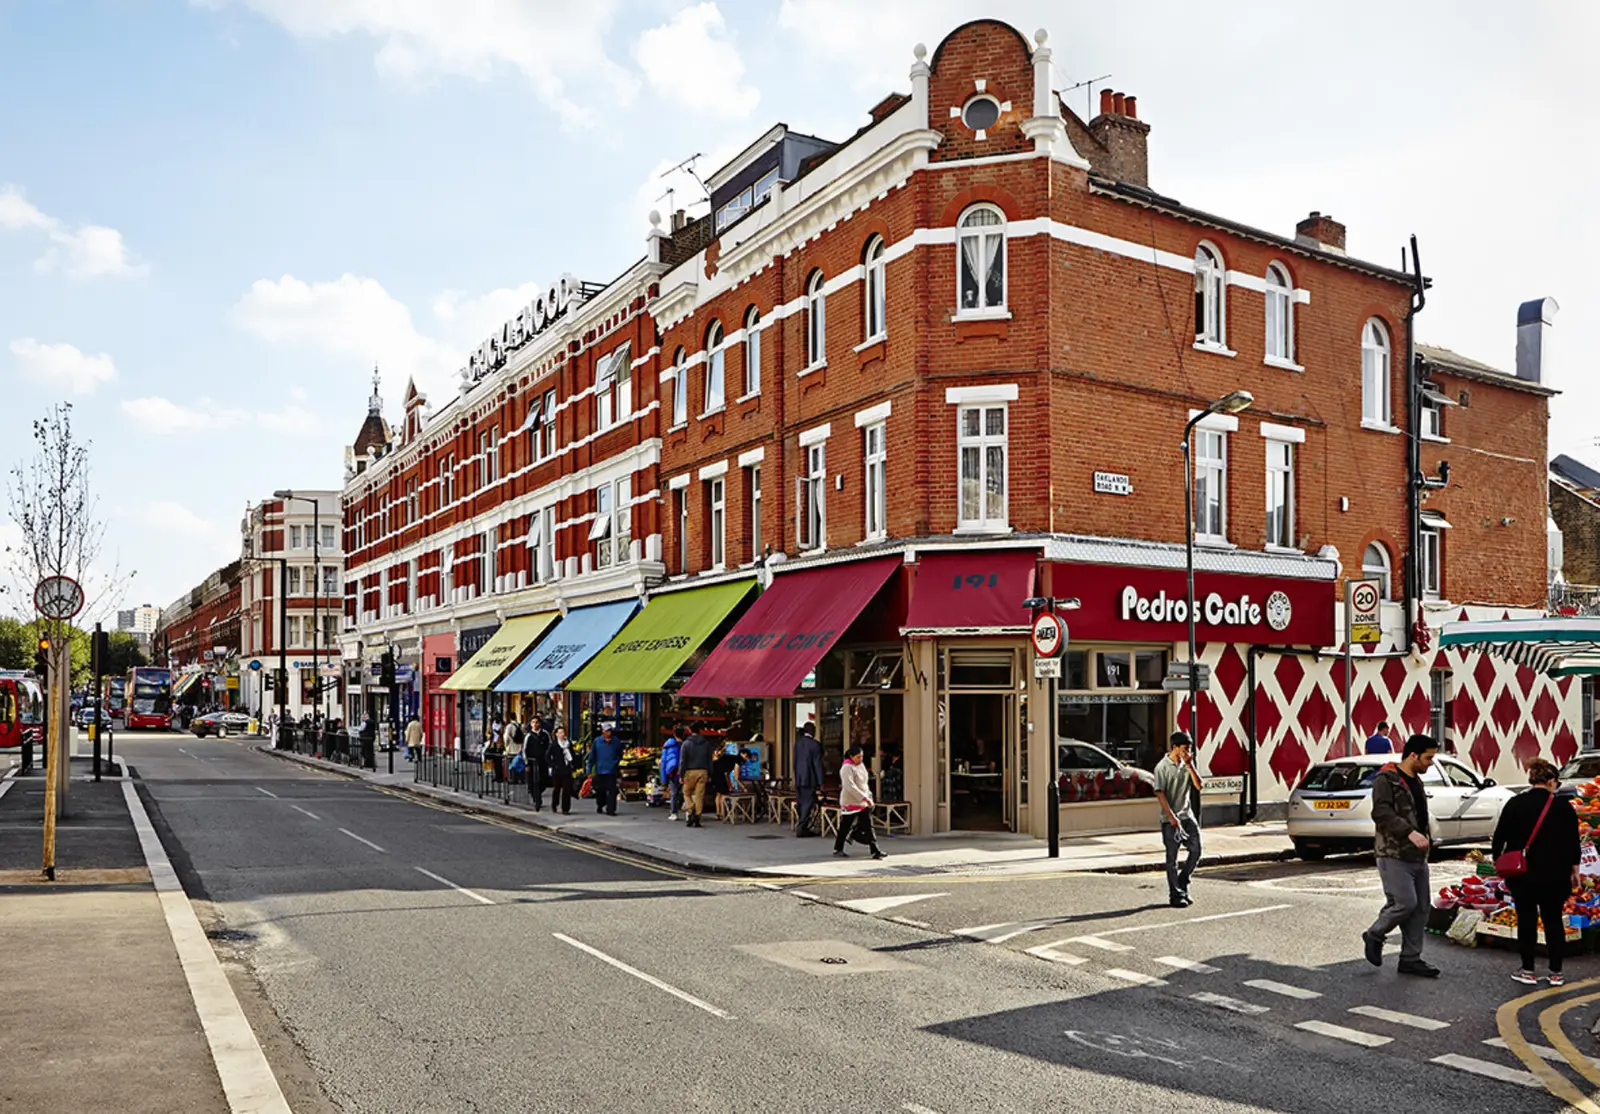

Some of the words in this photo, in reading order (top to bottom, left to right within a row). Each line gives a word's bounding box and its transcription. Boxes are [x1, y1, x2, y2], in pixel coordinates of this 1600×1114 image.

[1096, 473, 1128, 484] OAKLANDS
[1096, 481, 1112, 491] ROAD
[952, 573, 998, 590] 191
[1356, 591, 1374, 605] 20
[1205, 592, 1262, 625] Cafe
[1354, 613, 1376, 623] ZONE
[612, 639, 650, 654] BUDGET
[645, 635, 691, 650] EXPRESS
[785, 629, 837, 650] CAFE
[1107, 664, 1120, 676] 191
